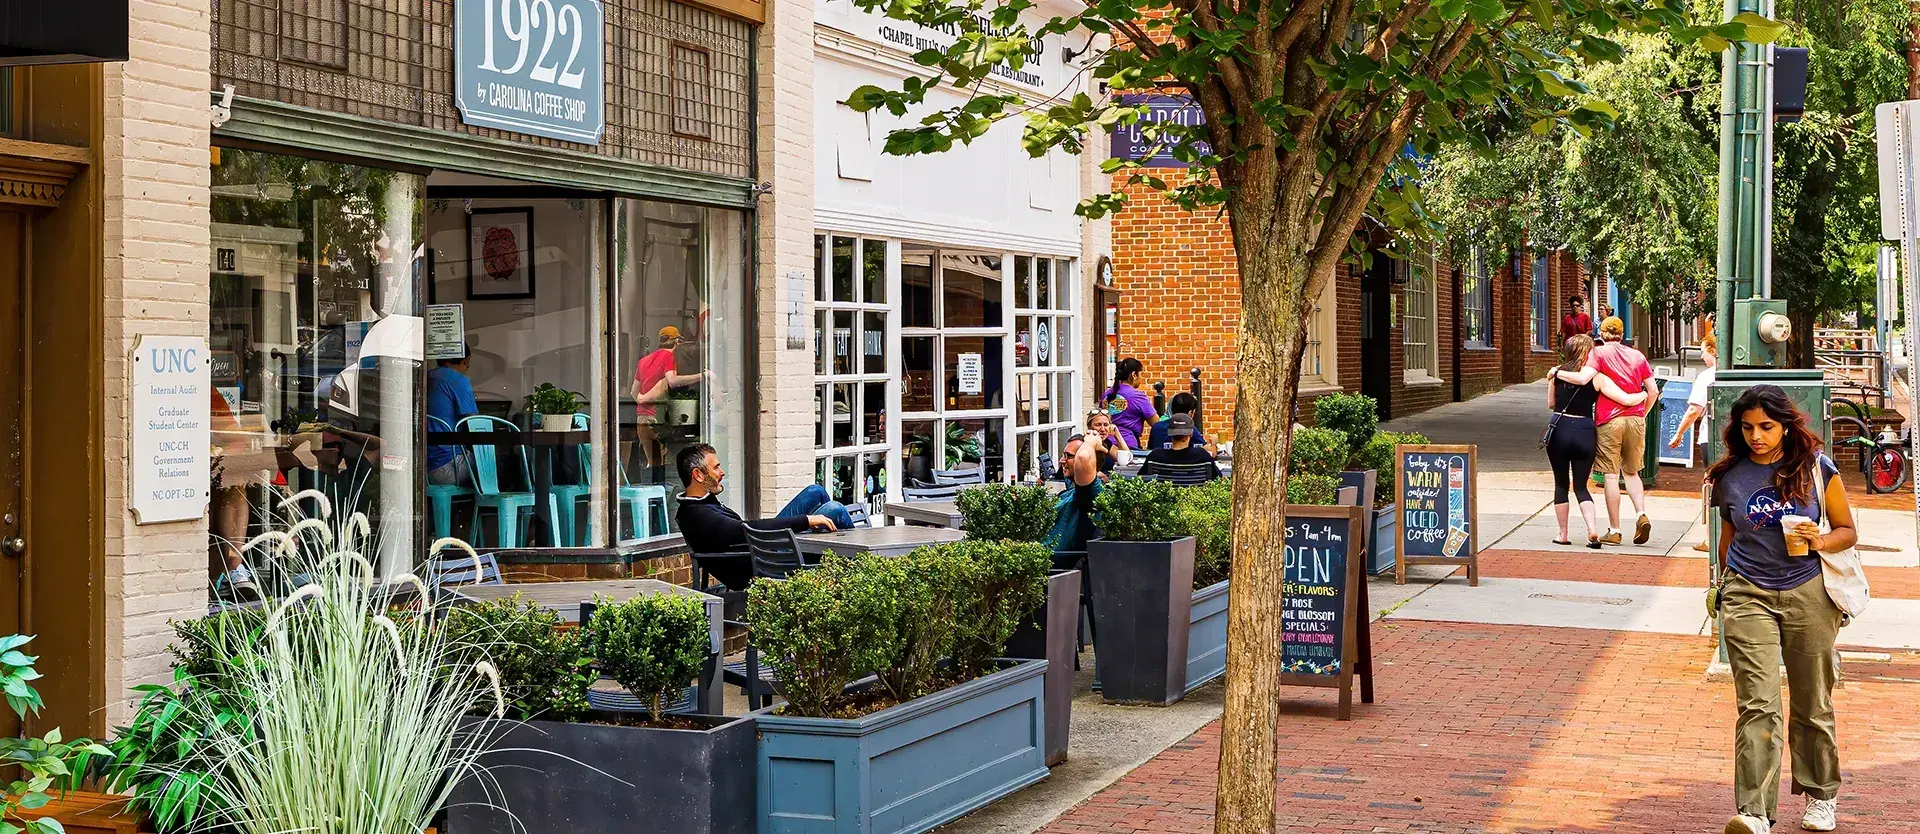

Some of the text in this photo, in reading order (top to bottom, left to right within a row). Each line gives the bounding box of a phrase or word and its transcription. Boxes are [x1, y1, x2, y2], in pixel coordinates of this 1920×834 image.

[882, 25, 915, 48] CHAPEL
[477, 0, 586, 90] 1922
[1001, 64, 1041, 88] RESTAURANT
[477, 82, 586, 122] by CAROLINA COFFEE SHOP
[218, 250, 235, 271] 140
[837, 329, 848, 356] EAT
[151, 348, 197, 374] UNC
[150, 385, 197, 395] Internal Audit
[158, 407, 190, 417] Graduate
[149, 420, 199, 431] Student Center
[1669, 413, 1678, 441] Cente
[158, 440, 189, 452] UNC-CH
[153, 455, 194, 466] Government
[1407, 454, 1448, 473] baby it's
[158, 468, 189, 479] Relations
[1406, 471, 1443, 488] WARM
[152, 490, 164, 501] NC
[164, 489, 181, 500] OPT
[1407, 488, 1440, 499] outside!
[1405, 499, 1435, 510] HAVE AN
[1749, 501, 1795, 514] NASA
[1406, 510, 1439, 529] ICED
[1407, 528, 1446, 543] coffee
[1283, 544, 1330, 583] PEN
[1291, 598, 1314, 608] ROSE
[1298, 610, 1335, 621] BLOSSOM
[1285, 621, 1329, 632] SPECIALS:
